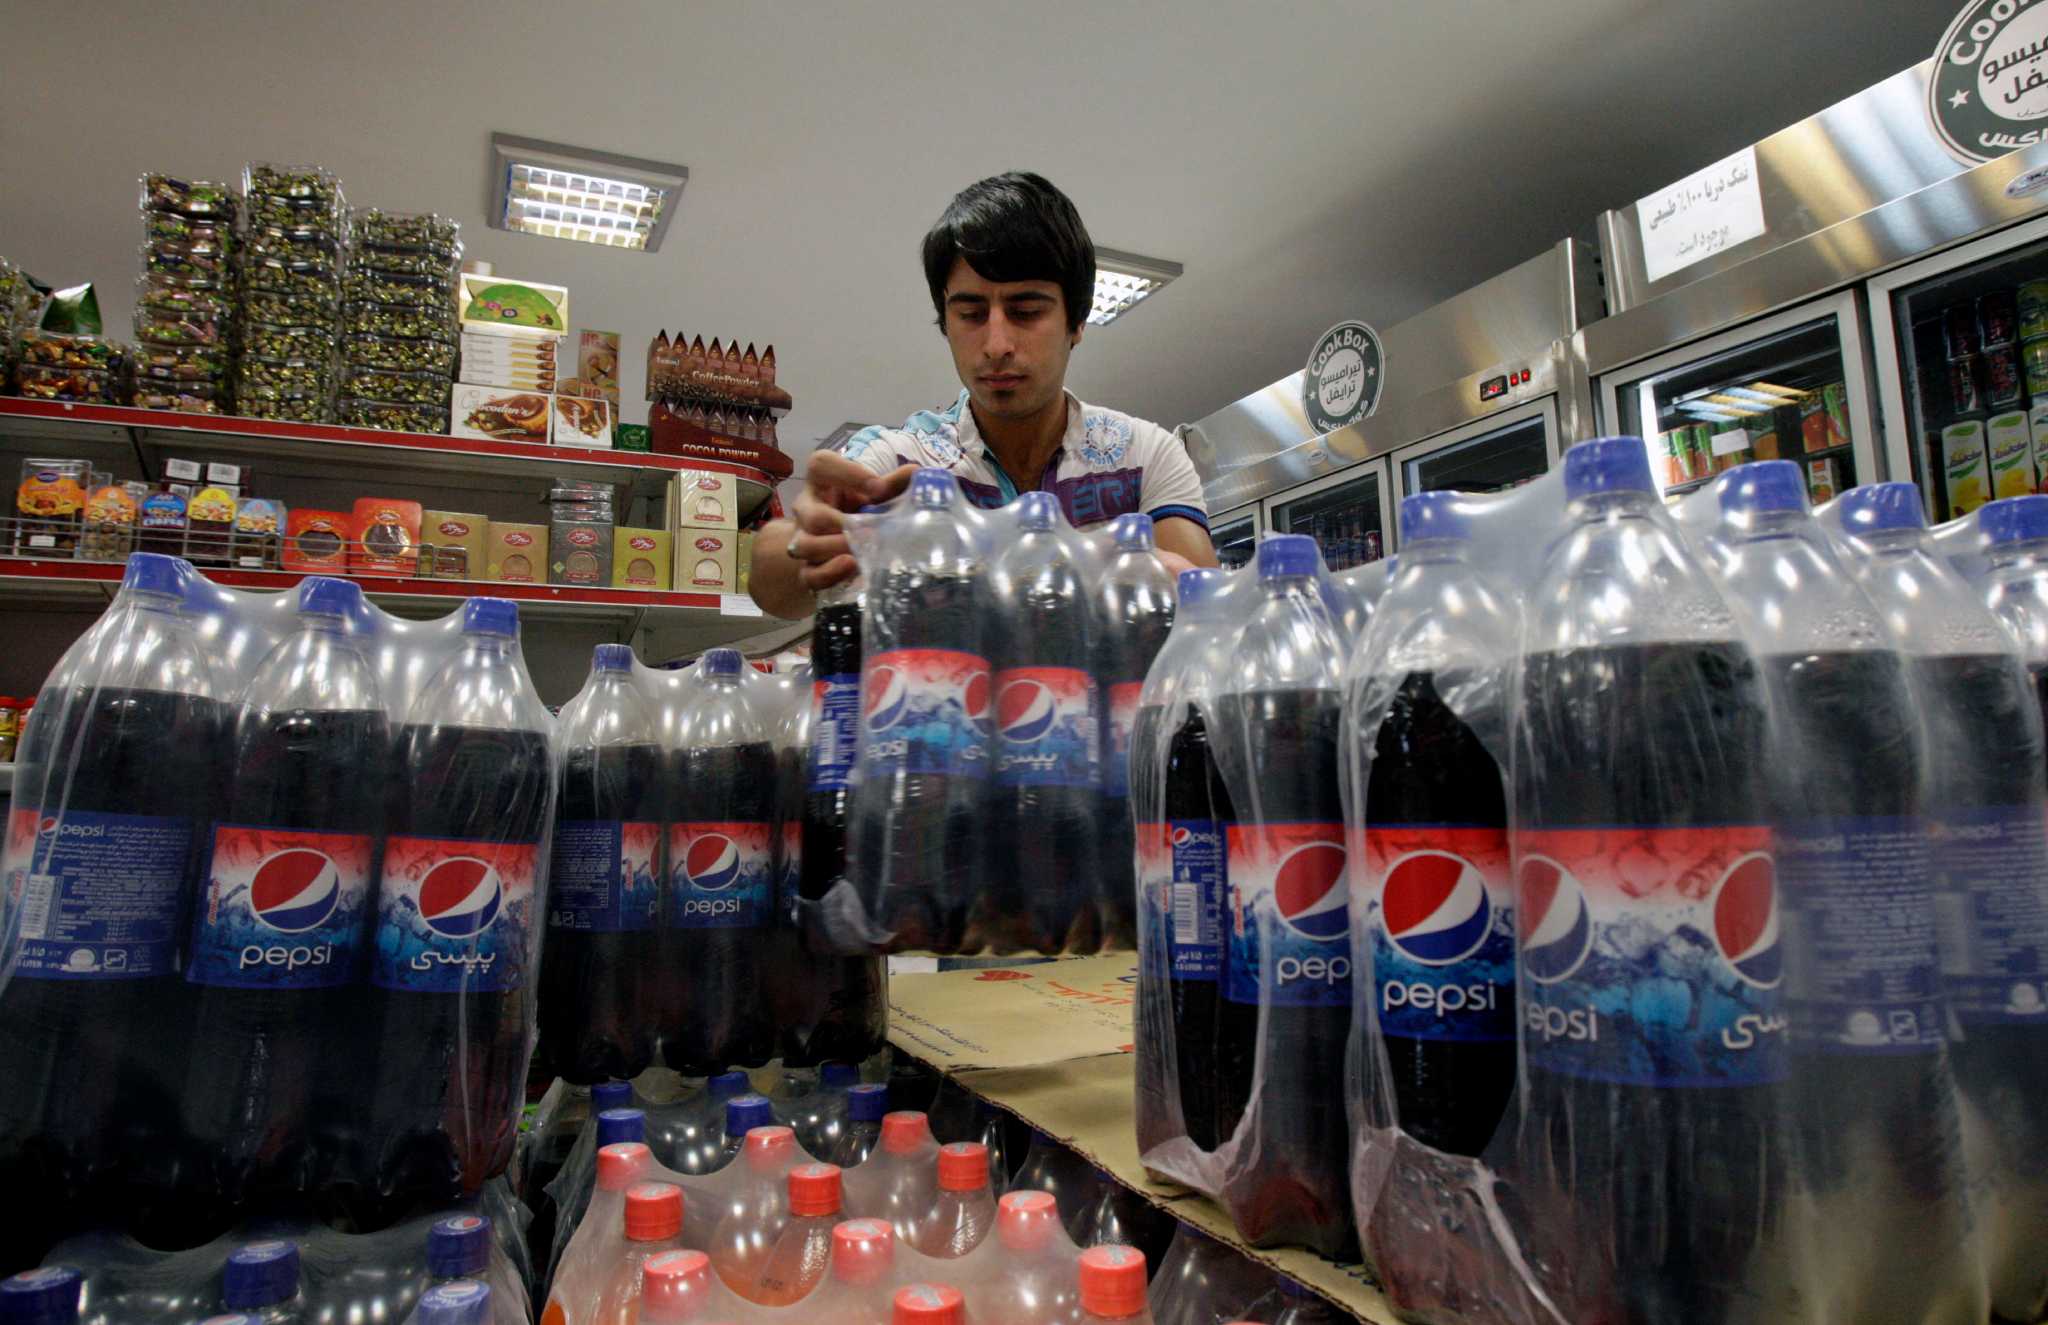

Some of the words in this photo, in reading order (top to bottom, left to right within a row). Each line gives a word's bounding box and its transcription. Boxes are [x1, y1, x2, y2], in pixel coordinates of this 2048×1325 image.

[59, 824, 105, 838] pepsi
[1190, 833, 1218, 846] pep
[684, 898, 740, 917] pepsi
[239, 943, 333, 970] pepsi
[410, 947, 496, 974] پپسی
[1277, 955, 1352, 985] pep
[1383, 978, 1496, 1017] pepsi
